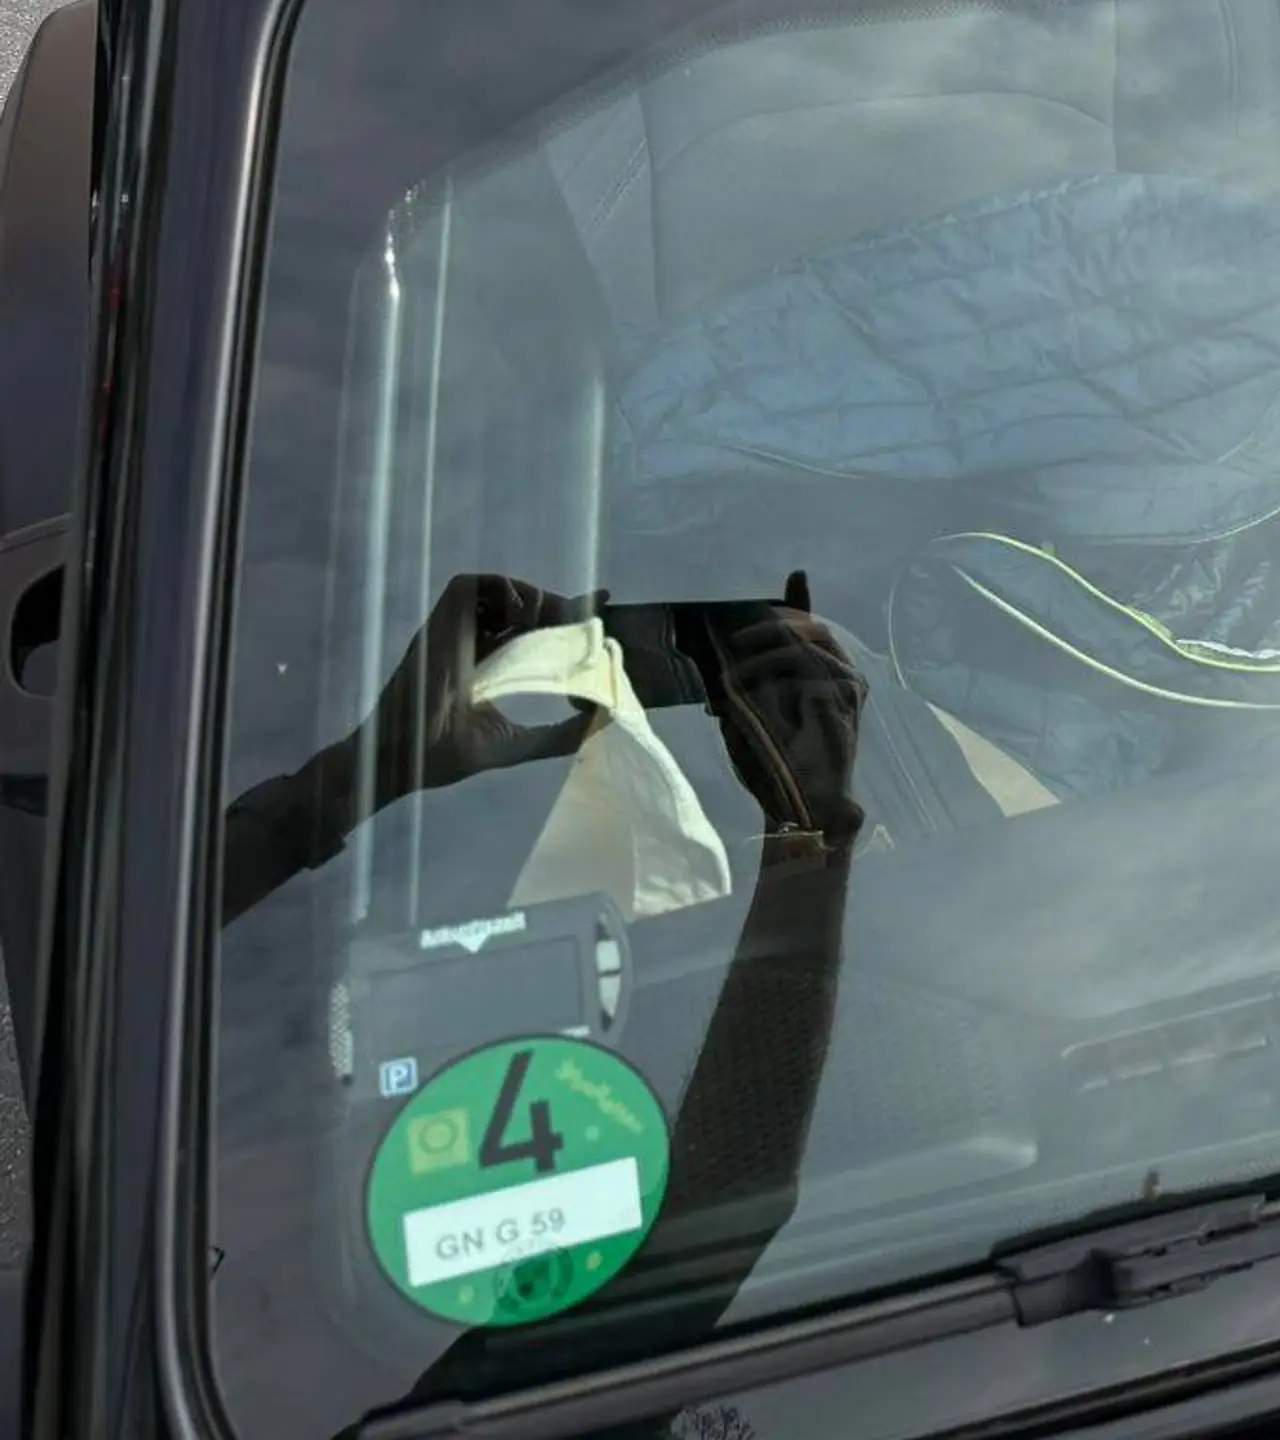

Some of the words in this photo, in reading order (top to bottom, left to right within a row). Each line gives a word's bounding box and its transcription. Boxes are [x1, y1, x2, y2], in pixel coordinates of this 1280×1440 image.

[479, 1048, 563, 1173] 4
[435, 1227, 484, 1261] GN
[496, 1217, 519, 1244] G
[532, 1207, 566, 1234] 59
